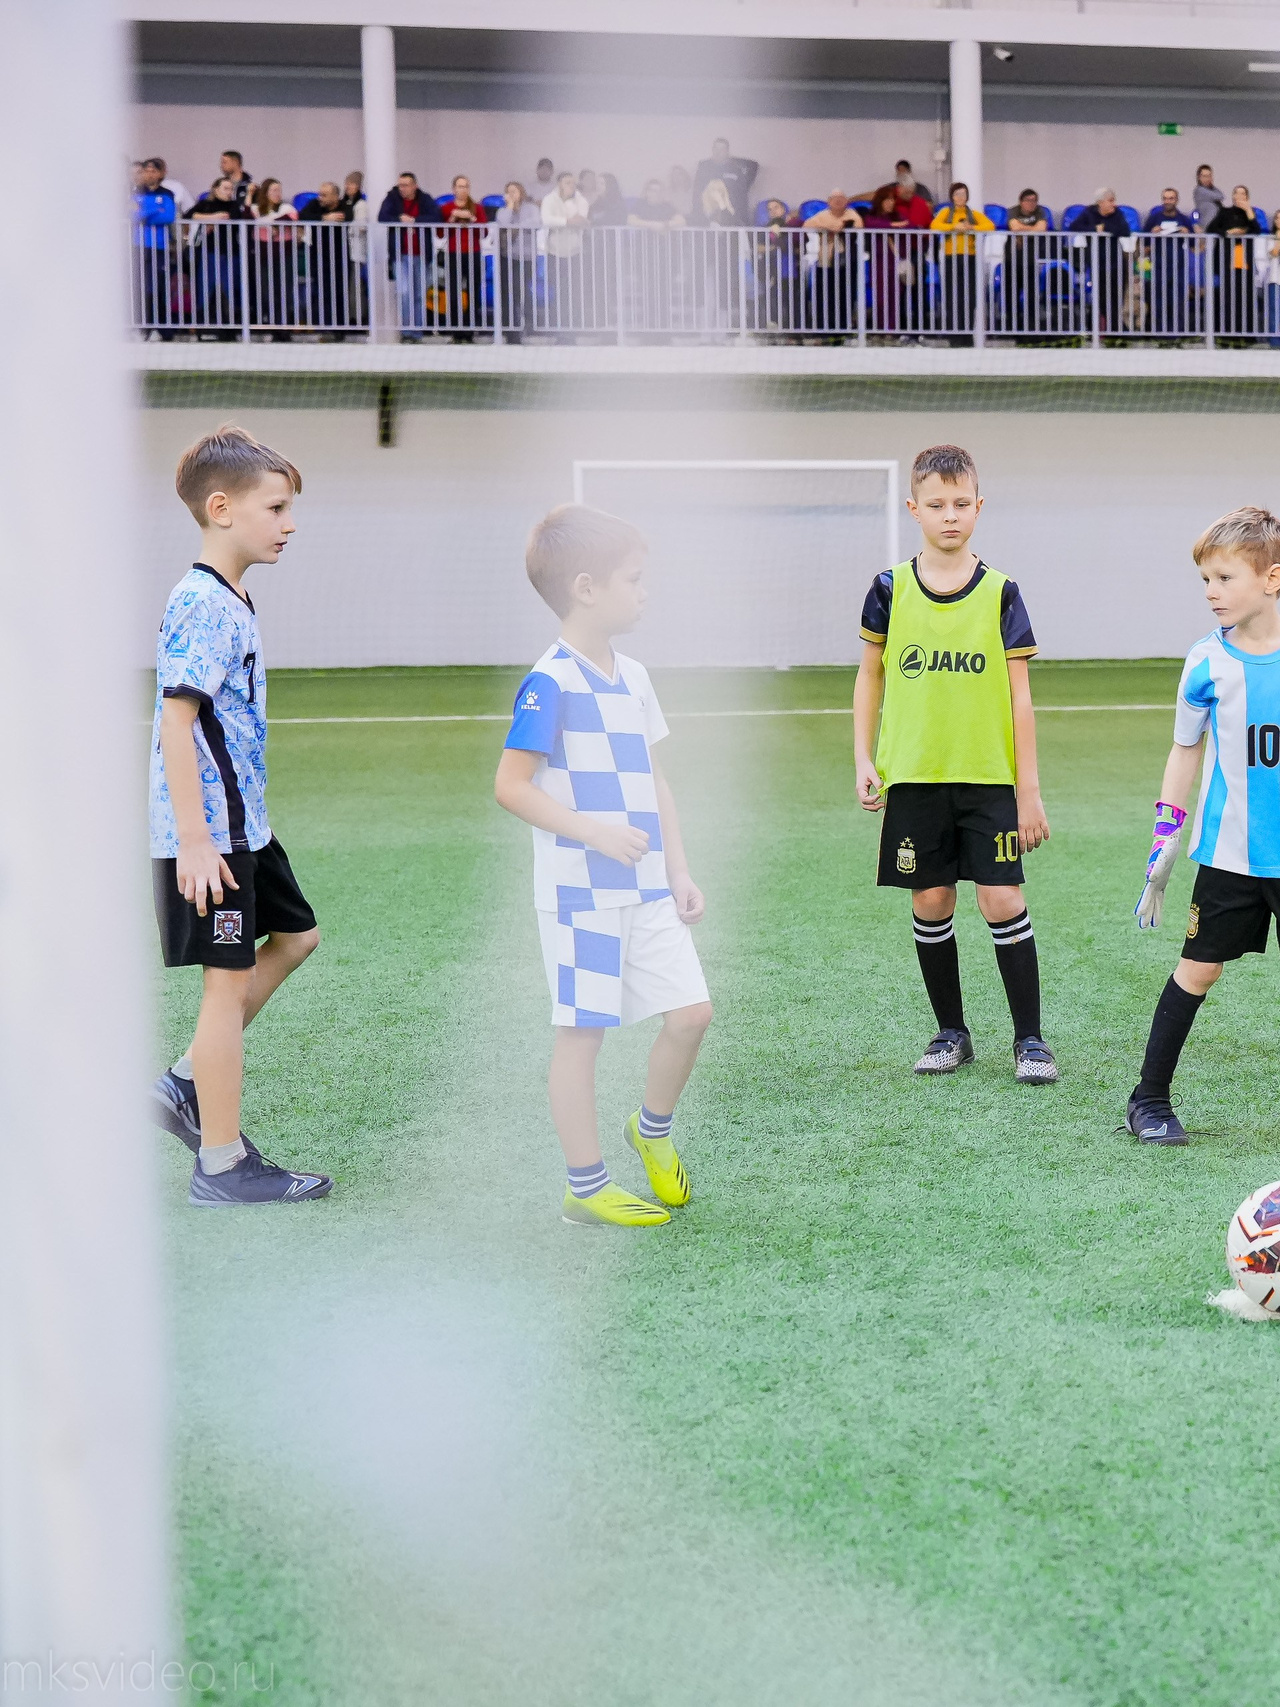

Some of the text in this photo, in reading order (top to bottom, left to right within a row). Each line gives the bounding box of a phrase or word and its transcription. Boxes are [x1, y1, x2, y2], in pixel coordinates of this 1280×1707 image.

[242, 651, 256, 705] 7
[927, 650, 986, 674] JAKO
[1247, 724, 1280, 768] 10
[993, 831, 1018, 862] 10
